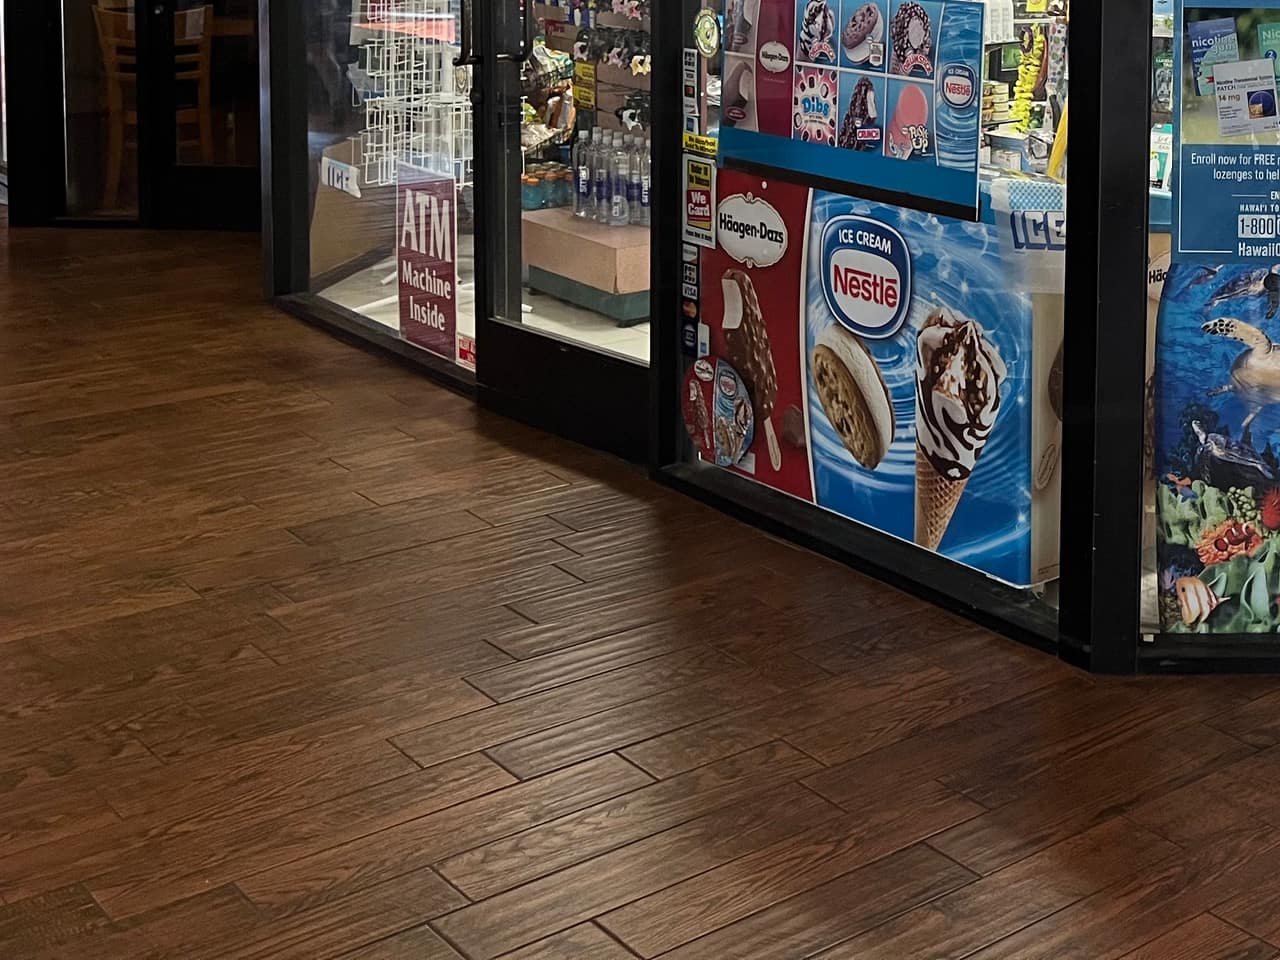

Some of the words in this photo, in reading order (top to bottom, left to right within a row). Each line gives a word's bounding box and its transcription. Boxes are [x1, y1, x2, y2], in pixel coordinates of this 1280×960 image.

[801, 97, 830, 116] Dibs
[1191, 153, 1216, 165] Enroll
[1218, 155, 1236, 165] now
[1239, 153, 1251, 165] for
[1254, 154, 1275, 166] FREE
[1213, 169, 1253, 182] lozenges
[1255, 170, 1264, 180] to
[688, 203, 710, 217] Card
[691, 192, 706, 204] We
[401, 188, 452, 262] ATM
[719, 212, 784, 244] Häagen-Dazs
[1011, 211, 1067, 251] ICE
[1239, 218, 1274, 235] 1-800
[838, 229, 854, 245] ICE
[857, 231, 893, 254] CREAM
[402, 260, 452, 299] Machine
[833, 264, 899, 308] Nestlé
[409, 296, 445, 331] Inside
